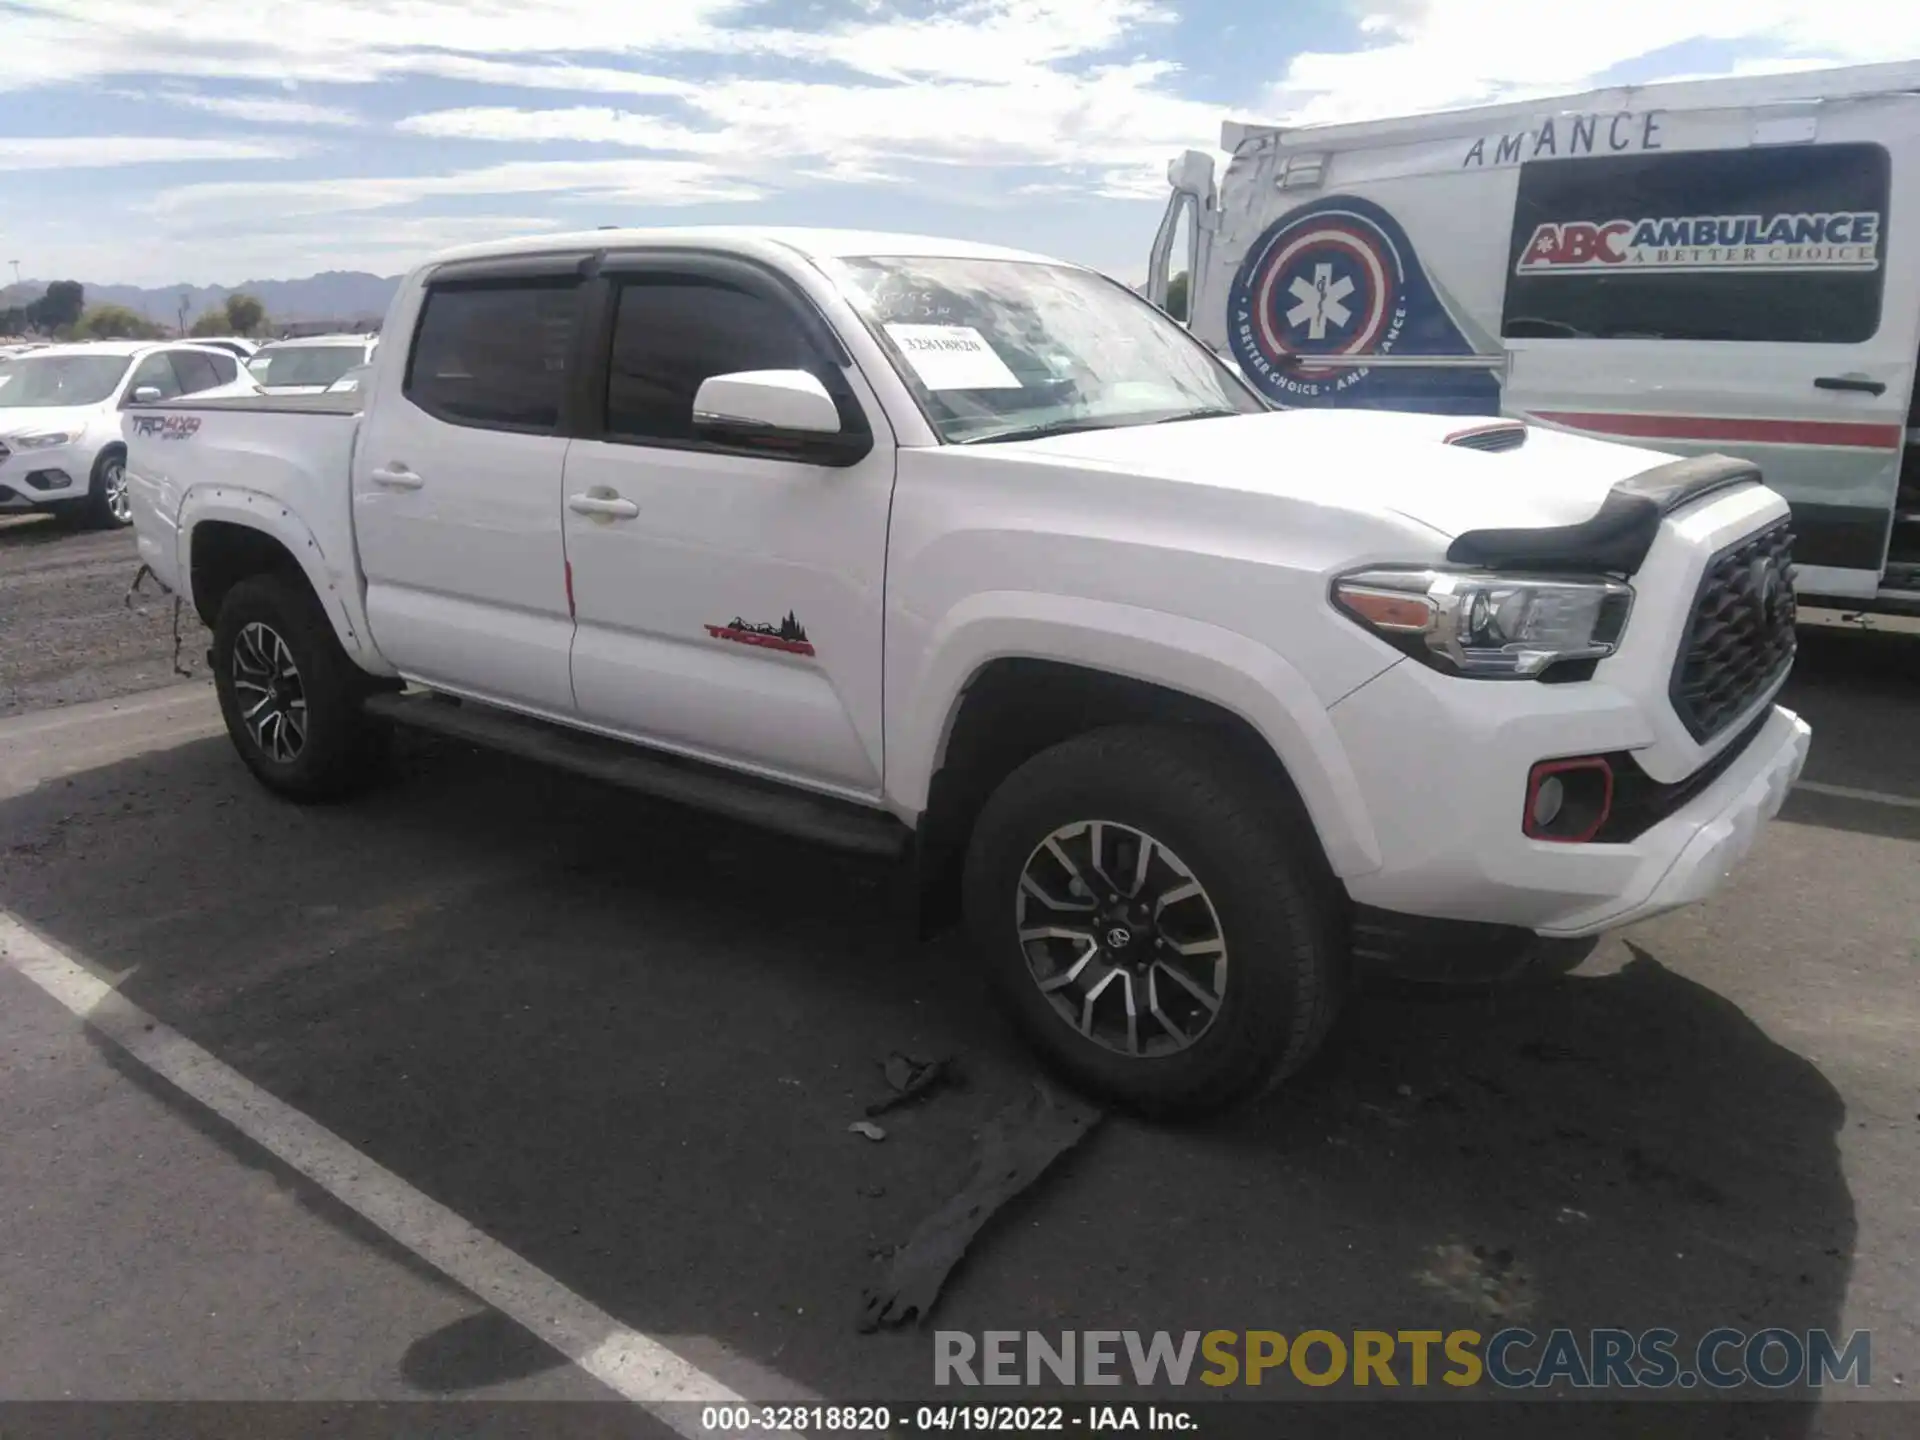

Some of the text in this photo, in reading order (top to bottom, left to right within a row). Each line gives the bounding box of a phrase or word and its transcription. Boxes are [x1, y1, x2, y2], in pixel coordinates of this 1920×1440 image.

[1522, 215, 1876, 265] ABC AMBULANCE
[1632, 246, 1875, 263] A BETTER CHOICE
[1238, 311, 1248, 321] A
[1239, 326, 1271, 374] BETTER
[1269, 372, 1319, 395] CHOICE
